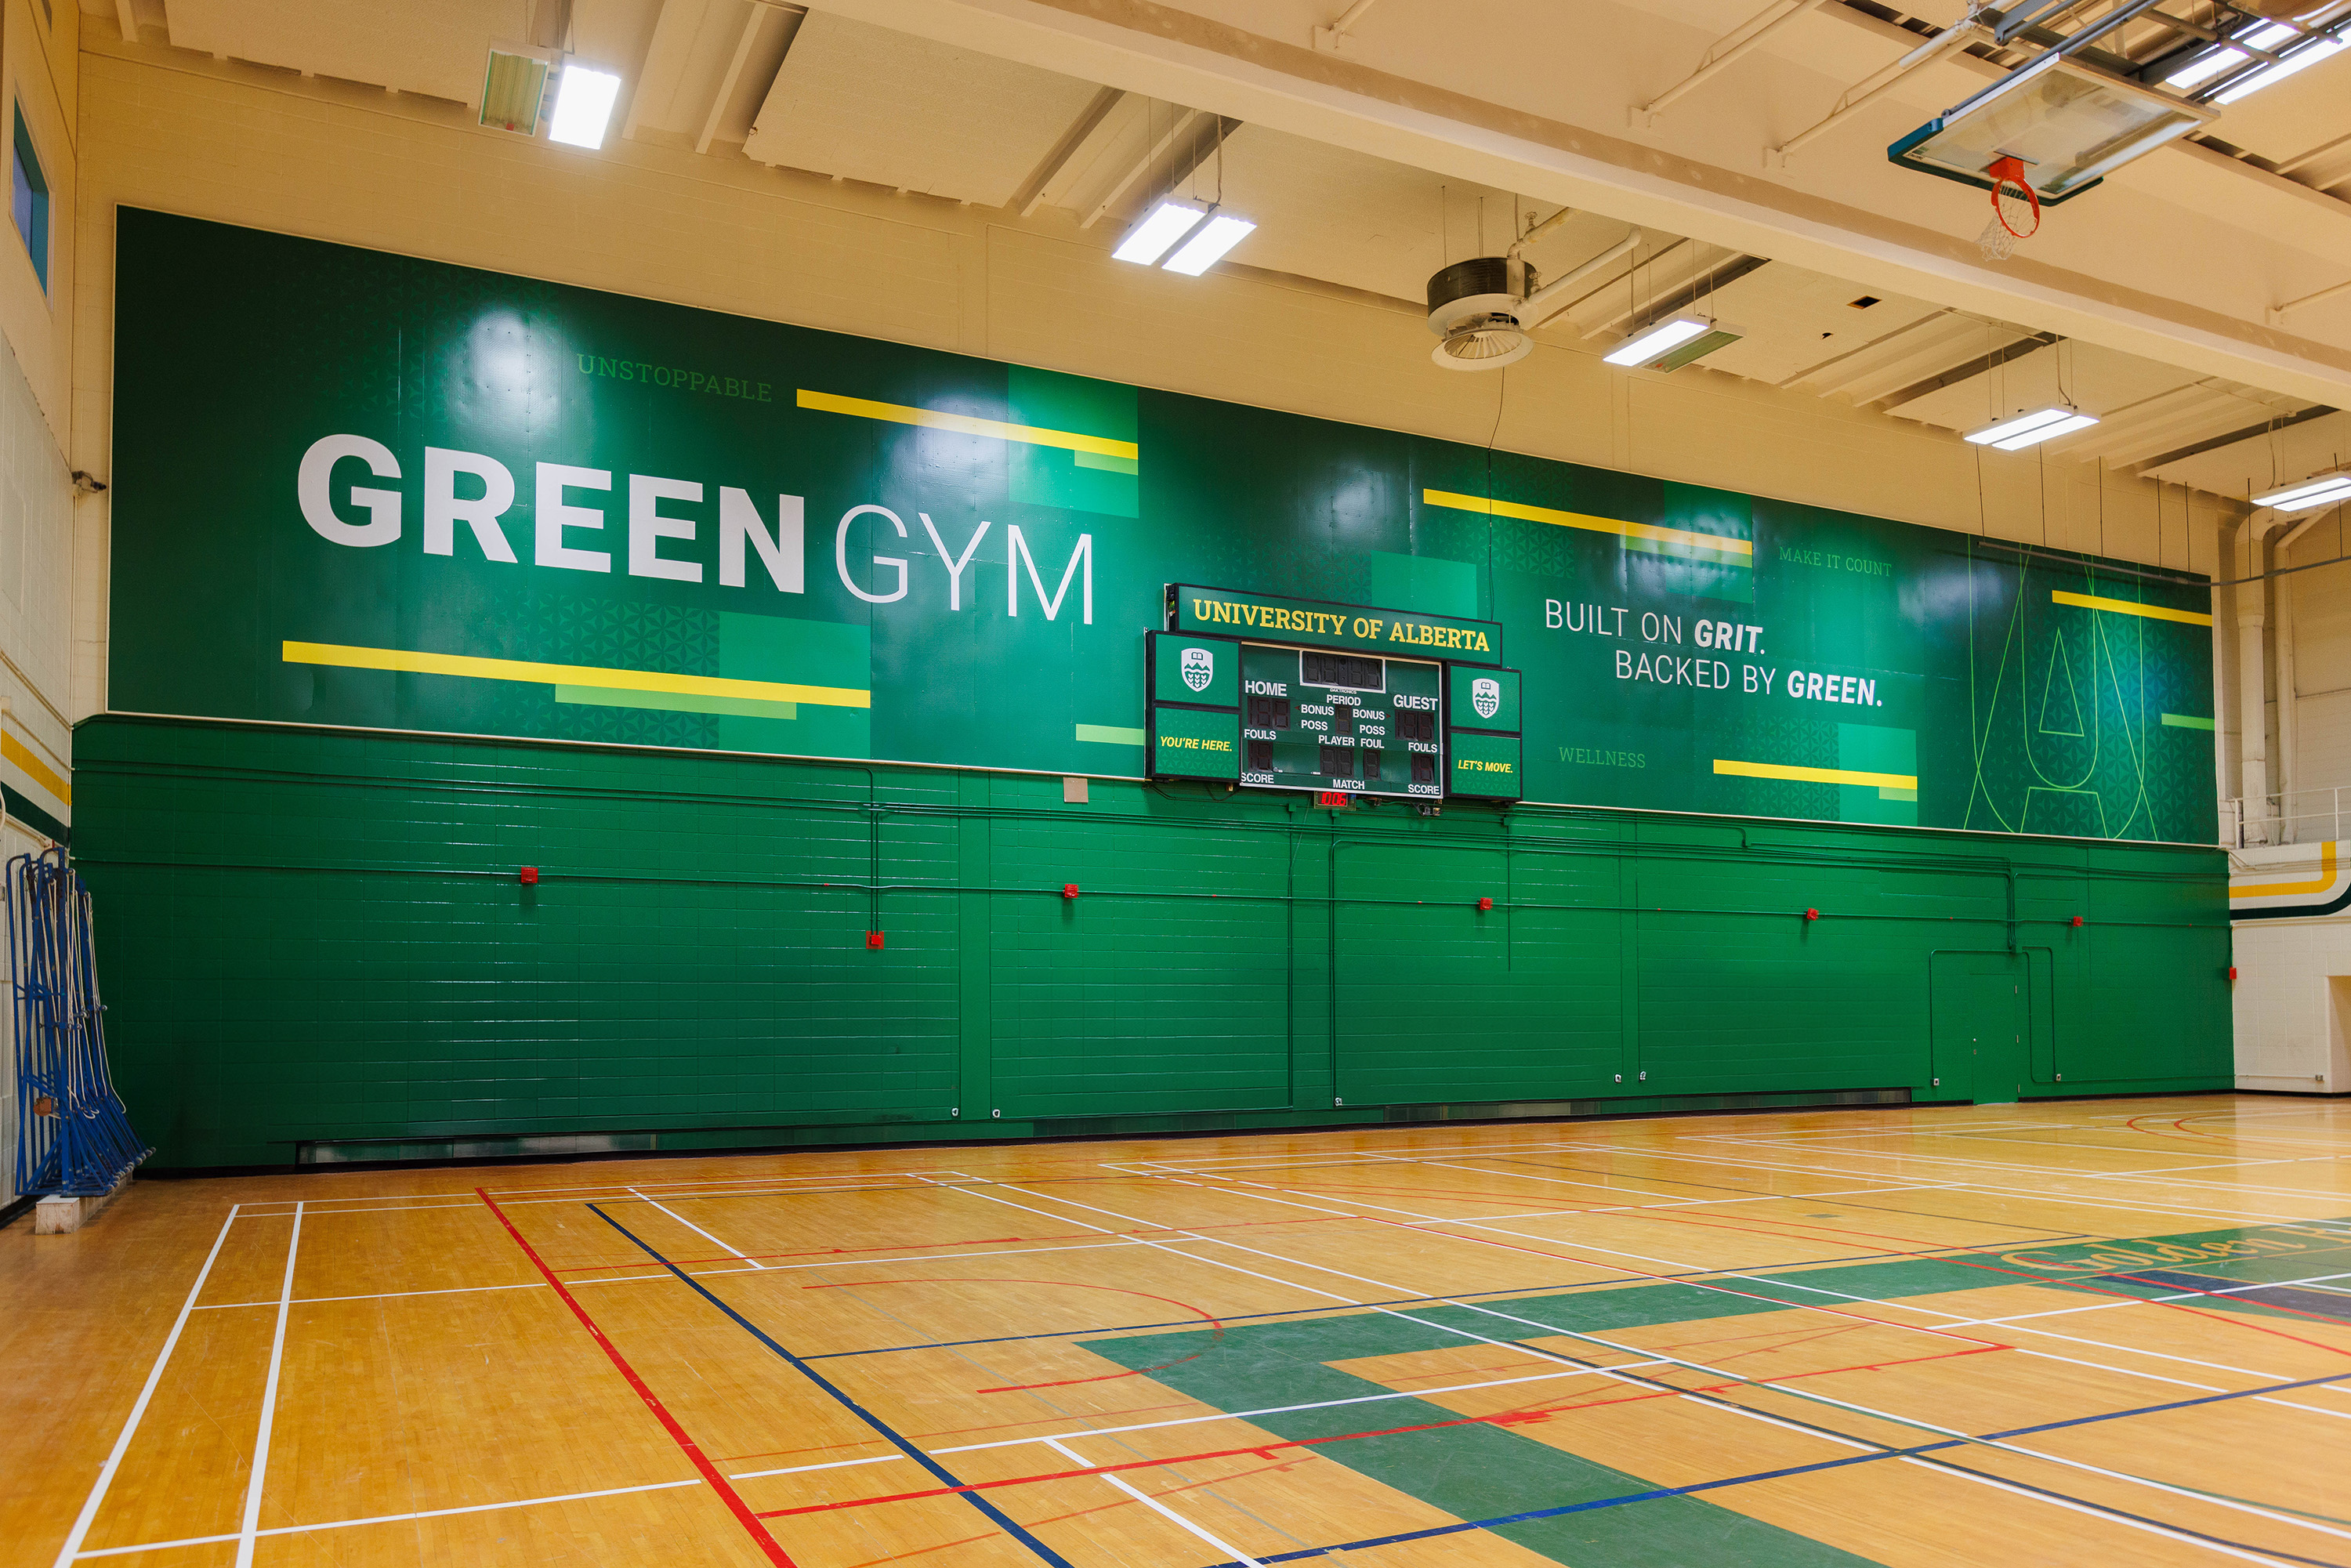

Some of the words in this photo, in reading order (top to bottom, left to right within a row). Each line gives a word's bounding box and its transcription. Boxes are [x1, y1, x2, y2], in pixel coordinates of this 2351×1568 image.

[577, 353, 773, 404] UNSTOPPABLE
[297, 433, 805, 595] GREEN
[835, 503, 1094, 625] GYM
[1779, 546, 1822, 564] MAKE
[1827, 555, 1841, 570] IT
[1846, 557, 1893, 578] COUNT
[1193, 599, 1347, 635] UNIVERSITY
[1353, 617, 1382, 639] OF
[1389, 621, 1491, 652] ALBERTA
[1545, 598, 1628, 636] BUILT
[1641, 612, 1682, 644] ON
[1694, 619, 1765, 655] GRIT.
[1615, 650, 1730, 690] BACKED
[1743, 664, 1776, 694] BY
[1787, 670, 1882, 708] GREEN.
[1244, 679, 1288, 697] HOME
[1326, 693, 1361, 706] PERIOD
[1393, 693, 1438, 711] GUEST
[1301, 704, 1335, 716] BONUS
[1353, 708, 1386, 721] BONUS
[1301, 719, 1328, 731] POSS
[1359, 724, 1386, 736] POSS
[1244, 729, 1277, 741] FOULS
[1318, 735, 1355, 747] PLAYER
[1360, 737, 1385, 749] FOUL
[1160, 735, 1201, 749] YOU'RE
[1202, 738, 1233, 752] HERE.
[1408, 741, 1438, 753] FOULS
[1559, 746, 1646, 769] WELLNESS
[1458, 759, 1483, 771] LET'S
[1485, 761, 1514, 773] MOVE.
[1241, 772, 1274, 784] SCORE
[1332, 778, 1365, 790] MATCH
[1407, 784, 1440, 795] SCORE
[2000, 1238, 2306, 1271] Golden
